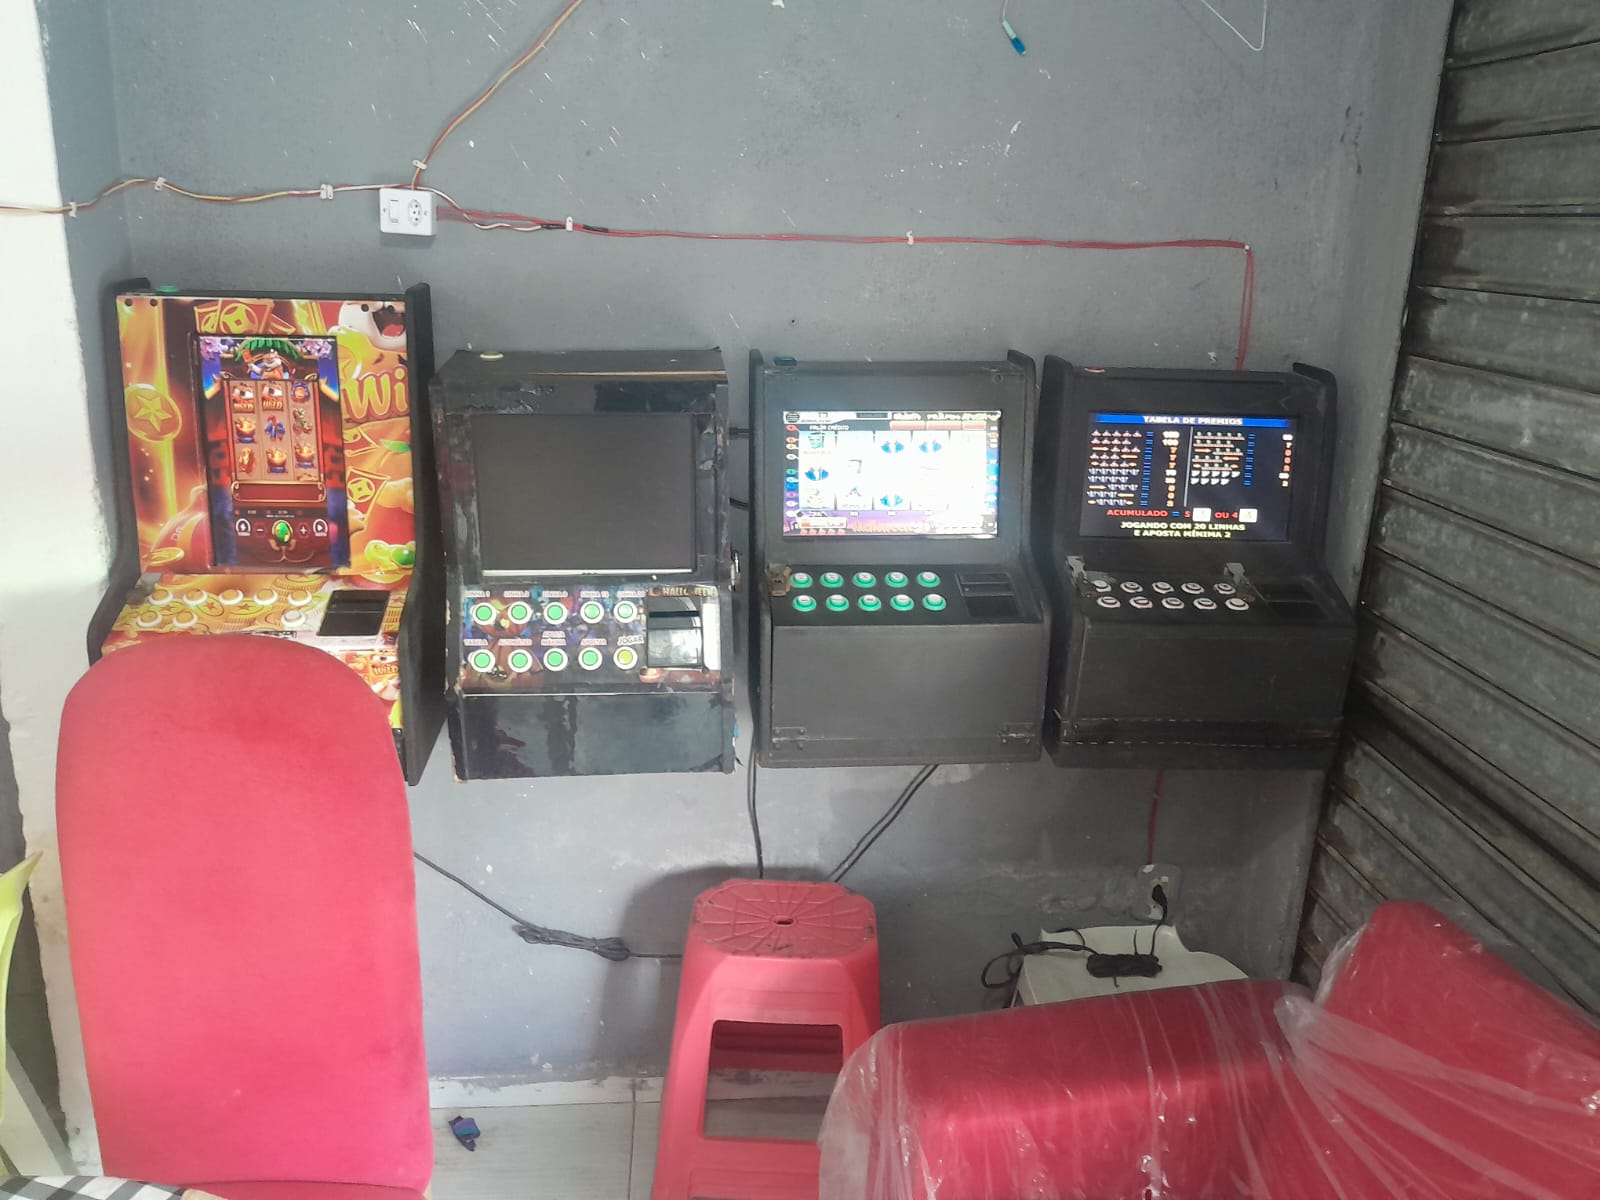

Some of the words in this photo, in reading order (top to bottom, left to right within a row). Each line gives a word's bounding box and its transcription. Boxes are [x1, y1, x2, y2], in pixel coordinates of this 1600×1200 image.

[1142, 415, 1180, 424] TABELA
[1182, 416, 1196, 425] DE
[1106, 509, 1169, 518] ACUMULADO
[1215, 511, 1230, 519] OU
[1120, 521, 1168, 530] JOGANDO
[1169, 522, 1192, 530] COM
[1193, 522, 1206, 530] 20
[1208, 523, 1246, 532] LINHAS
[1133, 529, 1141, 537] E
[1142, 529, 1182, 538] APOSTA
[1224, 530, 1231, 538] 2
[616, 634, 645, 646] JOGAR
